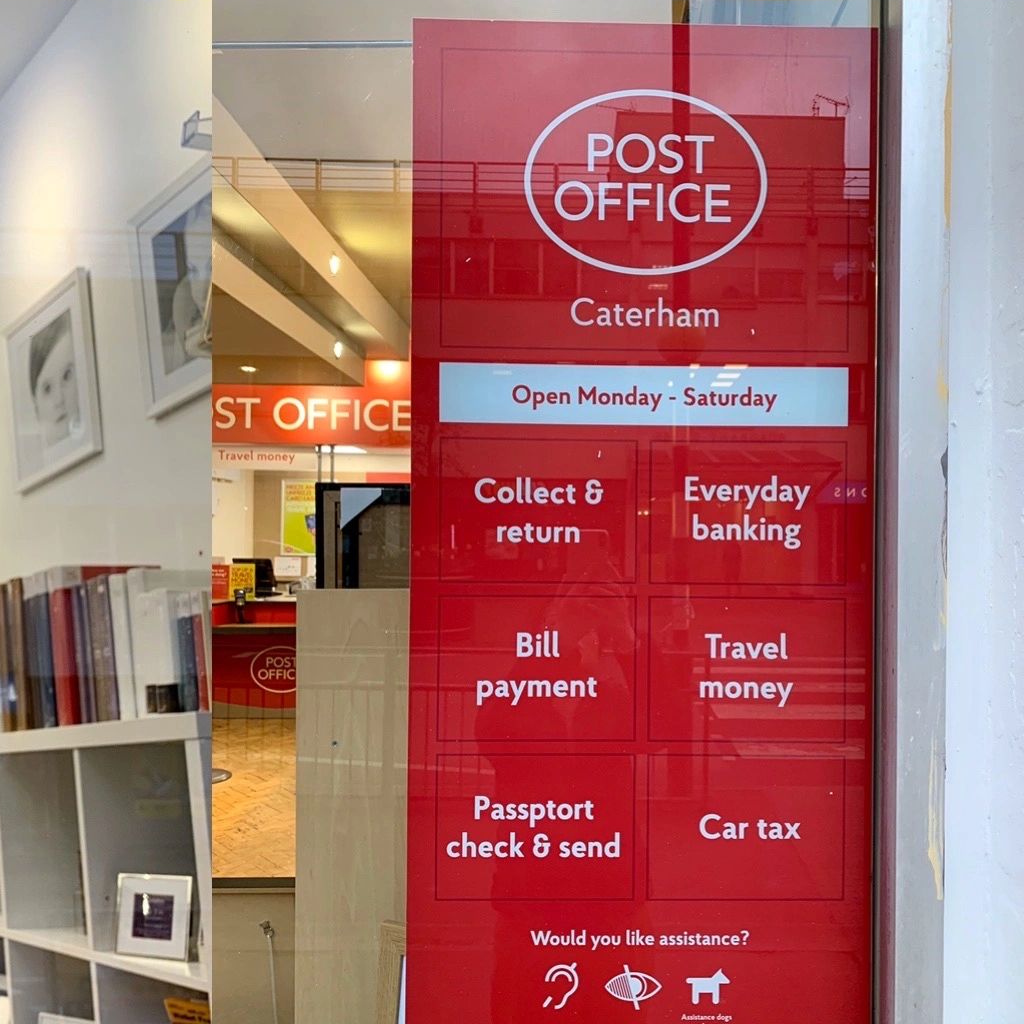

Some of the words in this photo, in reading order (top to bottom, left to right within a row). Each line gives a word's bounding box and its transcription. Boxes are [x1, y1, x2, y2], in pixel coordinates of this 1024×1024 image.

[587, 133, 714, 174] POST
[555, 180, 731, 222] OFFICE
[571, 297, 719, 327] Caterham
[512, 385, 570, 410] Open
[578, 386, 662, 412] Monday
[684, 386, 777, 412] Saturday
[272, 397, 411, 431] OFFICE
[218, 449, 254, 461] Travel
[257, 451, 295, 464] money
[475, 477, 576, 504] Collect
[585, 479, 603, 504] &
[685, 476, 810, 510] Everyday
[497, 523, 580, 543] return
[693, 514, 801, 549] banking
[517, 631, 559, 657] Bill
[705, 633, 788, 659] Travel
[477, 677, 597, 705] payment
[700, 681, 793, 707] money
[475, 796, 594, 827] Passptort
[699, 814, 748, 839] Car
[757, 820, 800, 839] tax
[447, 832, 524, 857] check
[533, 834, 550, 857] &
[560, 832, 620, 857] send
[531, 930, 586, 945] Would
[591, 935, 621, 950] you
[626, 930, 655, 945] like
[659, 930, 749, 945] assistance?
[681, 1013, 715, 1021] Assistance
[716, 1013, 733, 1023] dogs
